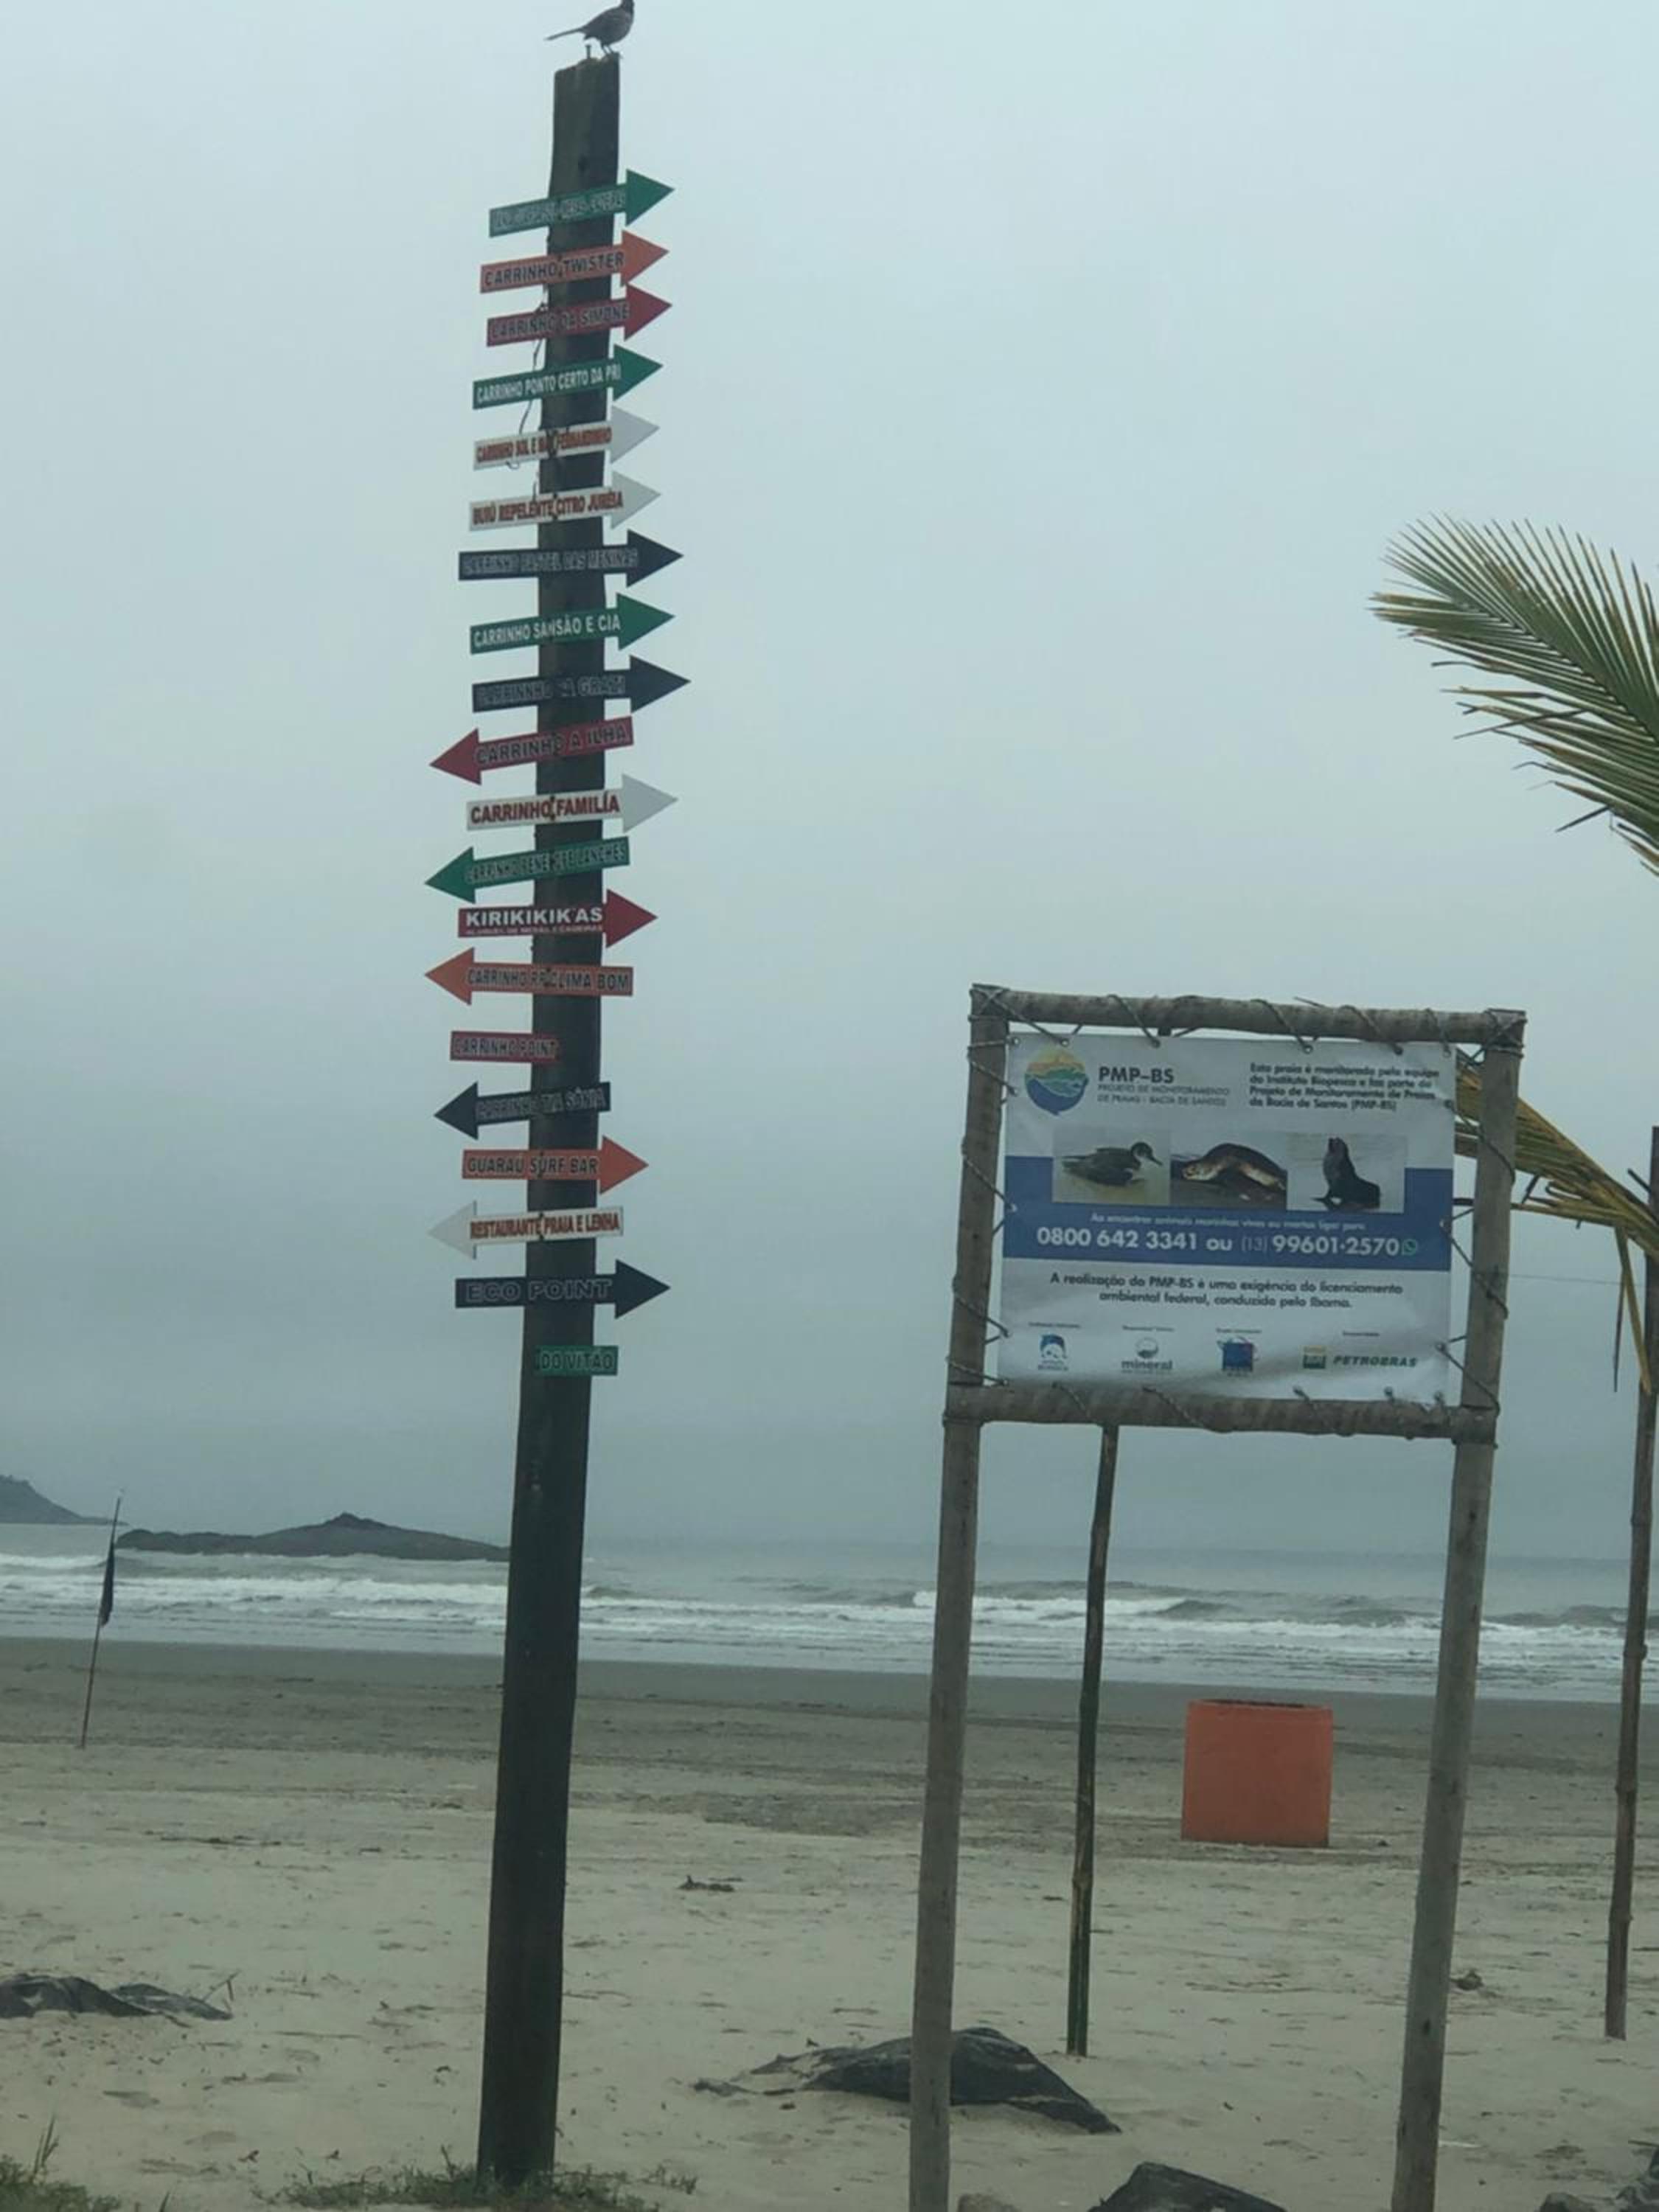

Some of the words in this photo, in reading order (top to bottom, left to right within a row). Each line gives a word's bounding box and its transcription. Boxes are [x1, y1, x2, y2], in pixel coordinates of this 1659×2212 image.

[484, 261, 555, 285] CARRINHO
[563, 251, 625, 274] TWISTER
[476, 382, 522, 403] CARRINHO
[525, 375, 555, 395] PONTO
[557, 370, 588, 390] CERTO
[591, 369, 604, 384] DA
[498, 498, 552, 522] REPELENTE
[474, 627, 530, 647] CARRINHO
[534, 614, 581, 639] SANSÃO
[585, 618, 594, 633] E
[599, 614, 621, 630] CIA
[475, 733, 566, 764] CARRINHO
[587, 723, 627, 747] ILHA
[471, 801, 552, 824] CARRINHO
[466, 907, 602, 927] KIRIKIKIKAS
[467, 968, 525, 987] CARRINHO
[597, 973, 628, 990] BOM
[455, 1037, 517, 1055] CARRINHO
[529, 1156, 564, 1173] SURF
[570, 1155, 599, 1173] BAR
[1037, 1227, 1091, 1246] 0800
[1097, 1229, 1138, 1248] 642
[1146, 1231, 1196, 1250] 3341
[1206, 1237, 1232, 1251] ou
[466, 1282, 520, 1303] ECO
[528, 1279, 612, 1301] POINT
[1050, 1272, 1060, 1284] A
[1063, 1272, 1126, 1289] realização
[1209, 1280, 1237, 1290] uma
[1099, 1290, 1161, 1303] ambiental
[1280, 1296, 1307, 1309] pelo
[1333, 1354, 1418, 1368] PETROBRAS
